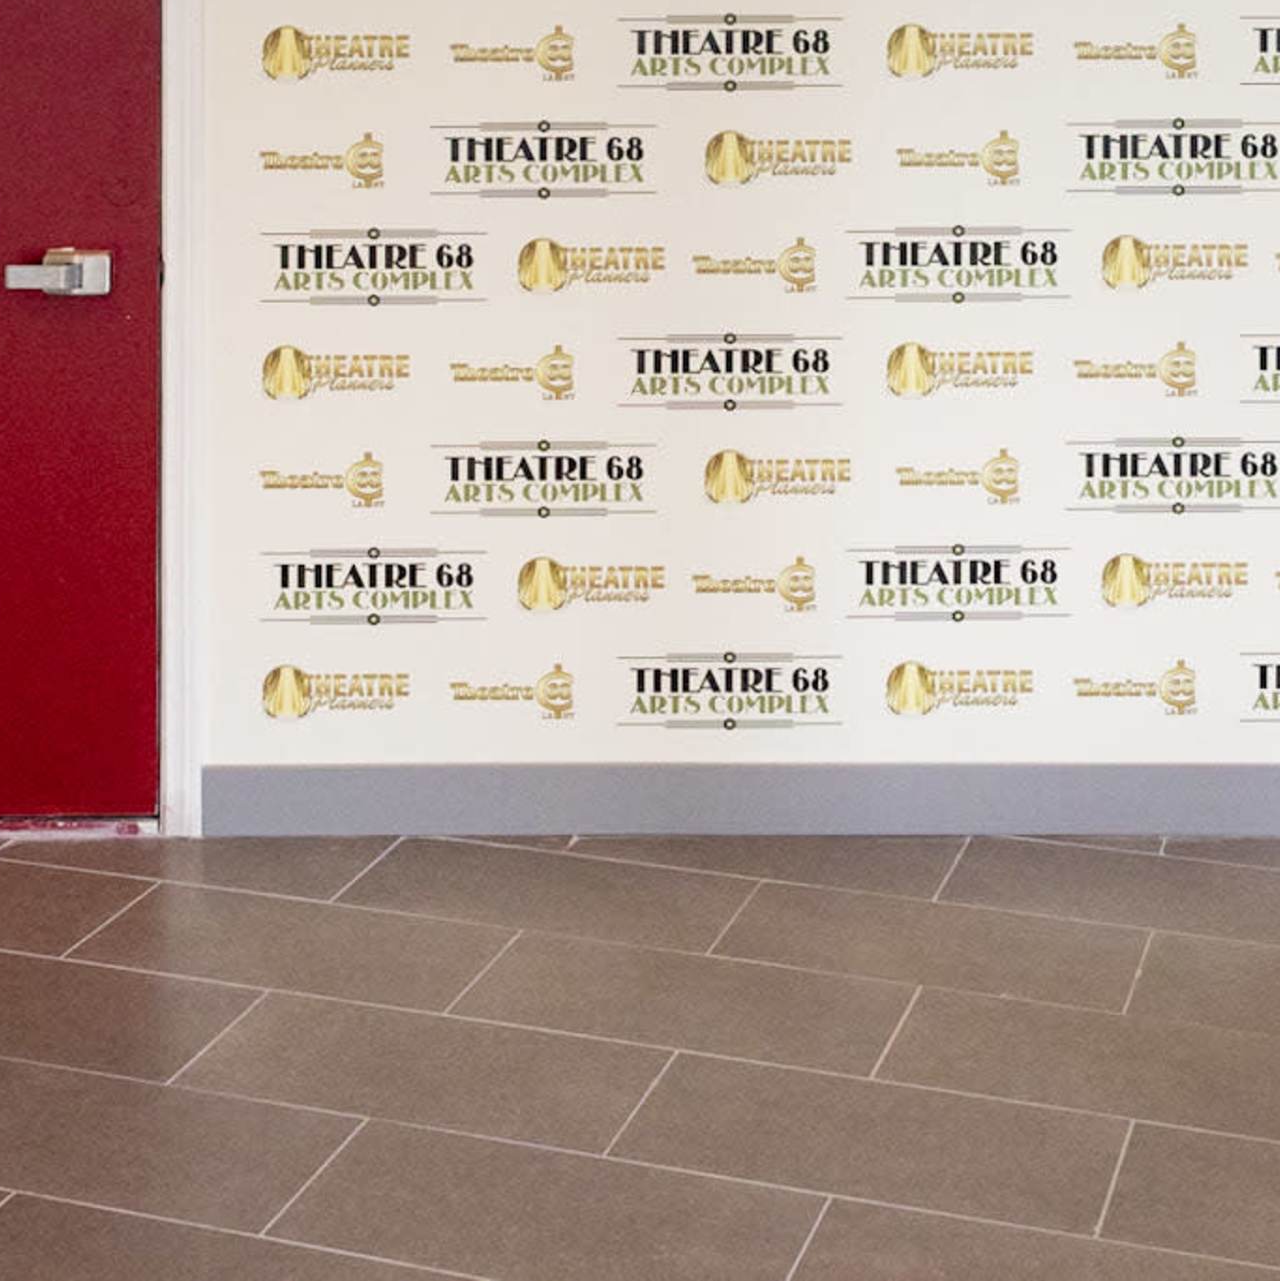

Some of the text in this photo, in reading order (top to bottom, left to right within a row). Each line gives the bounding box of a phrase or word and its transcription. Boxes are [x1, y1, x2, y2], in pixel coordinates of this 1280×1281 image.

[304, 34, 410, 59] THEATRE
[630, 29, 831, 56] THEATRE 68
[928, 32, 1034, 57] THEATRE
[630, 57, 831, 76] ARTS COMPLEX
[444, 136, 645, 163] THEATRE 68
[746, 139, 852, 164] THEATRE
[1078, 133, 1279, 160] THEATRE 68
[444, 164, 645, 183] ARTS COMPLEX
[1078, 161, 1279, 180] ARTS COMPLEX
[273, 243, 474, 270] THEATRE 68
[559, 246, 665, 271] THEATRE
[858, 240, 1059, 267] THEATRE 68
[1143, 243, 1249, 268] THEATRE
[273, 271, 474, 290] ARTS COMPLEX
[858, 268, 1059, 287] ARTS COMPLEX
[304, 354, 410, 379] THEATRE
[630, 348, 831, 375] THEATRE 68
[928, 351, 1034, 376] THEATRE
[630, 376, 831, 395] ARTS COMPLEX
[443, 455, 644, 482] THEATRE 68
[746, 458, 852, 483] THEATRE
[1078, 451, 1279, 478] THEATRE 68
[443, 483, 644, 502] ARTS COMPLEX
[1078, 479, 1279, 498] ARTS COMPLEX
[273, 562, 474, 589] THEATRE 68
[559, 565, 665, 590] THEATRE
[858, 559, 1059, 586] THEATRE 68
[1143, 561, 1249, 586] THEATRE
[273, 590, 474, 609] ARTS COMPLEX
[858, 587, 1059, 606] ARTS COMPLEX
[304, 673, 410, 698] THEATRE
[629, 667, 830, 694] THEATRE 68
[927, 669, 1033, 694] THEATRE
[629, 695, 830, 714] ARTS COMPLEX
